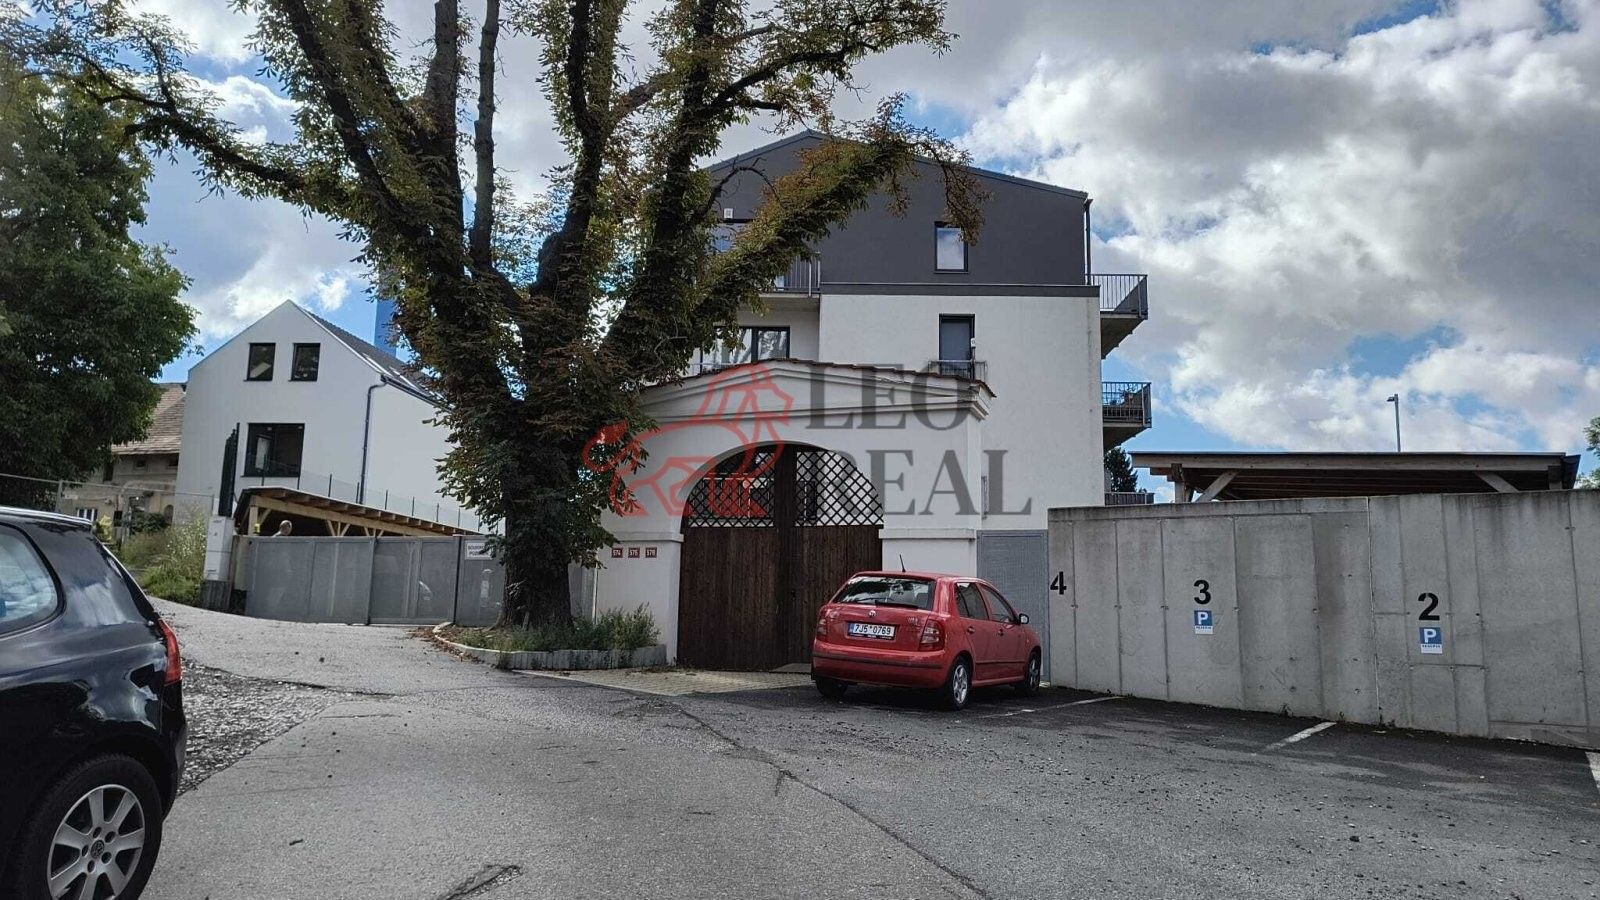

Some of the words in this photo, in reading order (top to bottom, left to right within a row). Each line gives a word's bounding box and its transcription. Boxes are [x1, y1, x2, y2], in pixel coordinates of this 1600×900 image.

[1050, 571, 1067, 595] 4
[1193, 579, 1211, 605] 3
[1417, 592, 1440, 621] 2
[1197, 611, 1209, 625] P
[854, 624, 868, 633] 7J5
[872, 625, 891, 635] 0769
[1423, 628, 1437, 643] P
